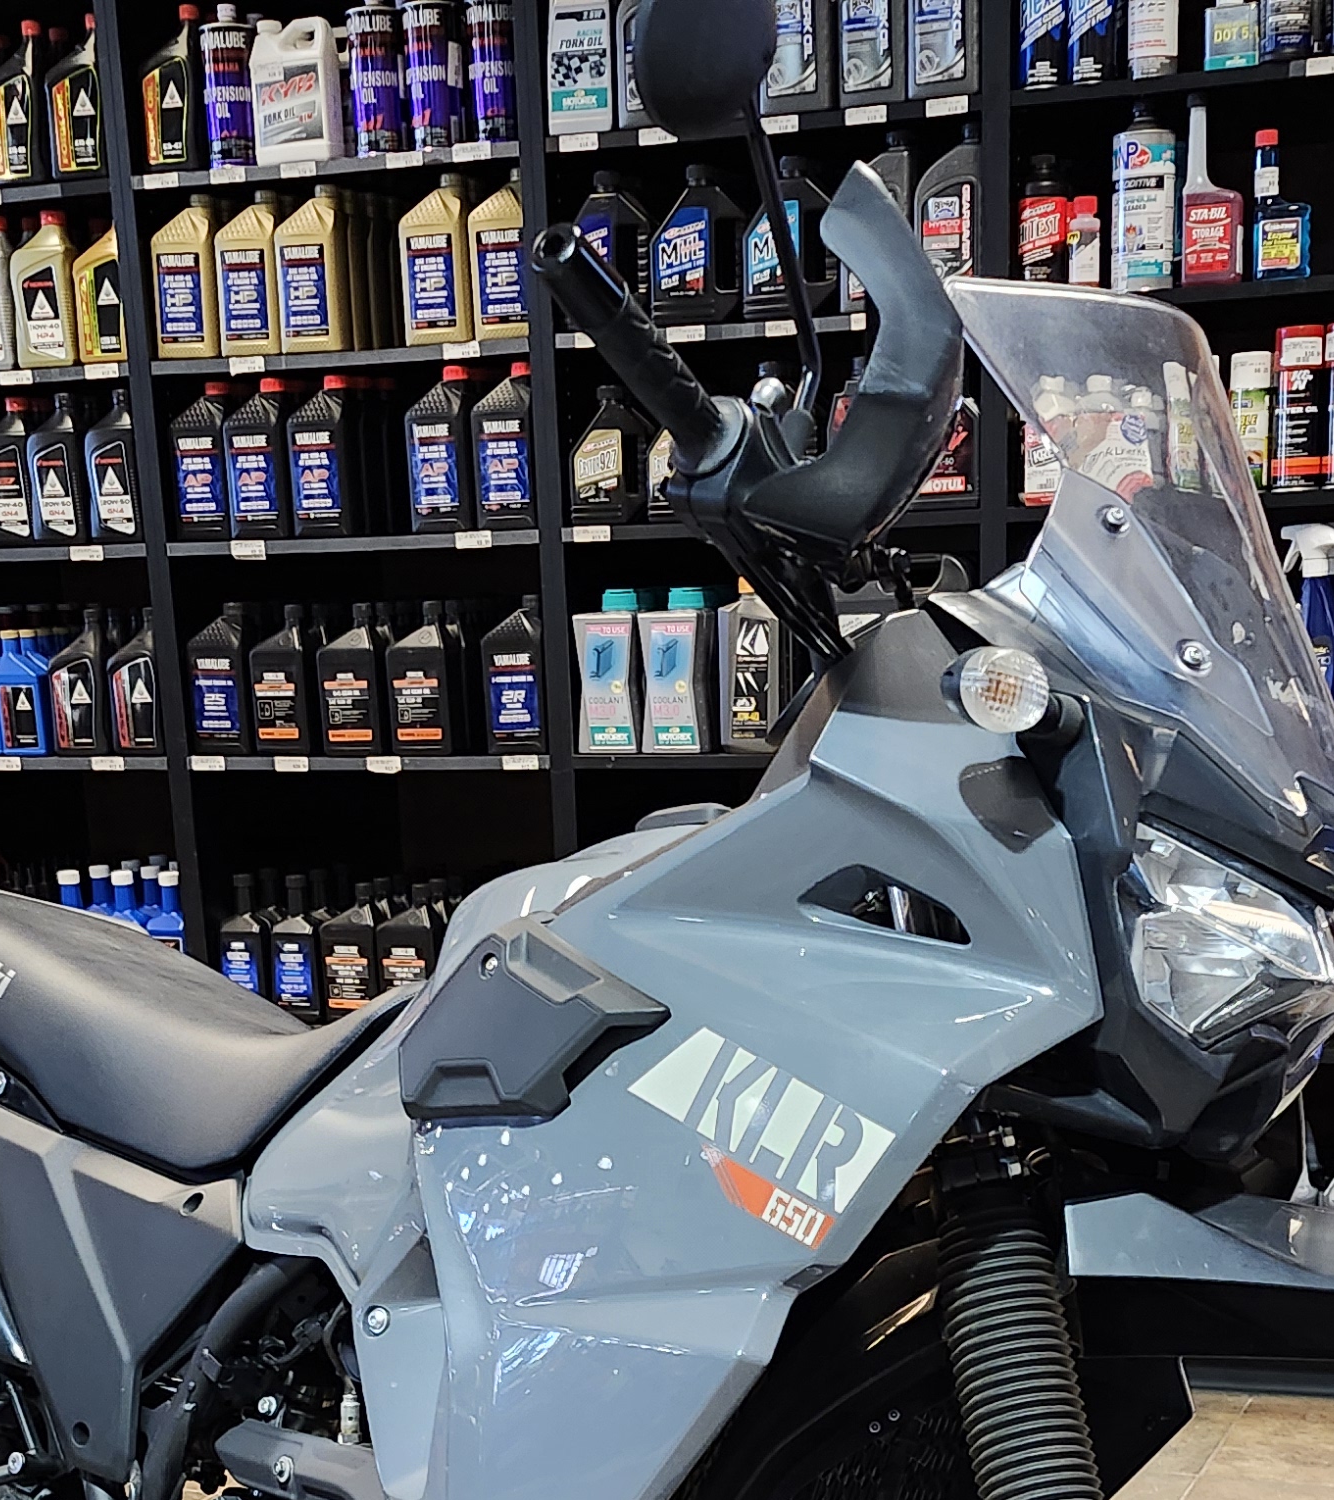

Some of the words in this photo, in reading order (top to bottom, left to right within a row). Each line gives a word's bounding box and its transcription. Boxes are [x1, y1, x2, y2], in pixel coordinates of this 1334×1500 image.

[1214, 29, 1238, 42] DOT
[559, 38, 585, 50] FORK
[586, 36, 603, 48] OIL
[261, 71, 316, 106] KYB
[484, 78, 499, 94] OIL
[216, 102, 231, 118] OIL
[264, 111, 282, 128] FORK
[284, 107, 295, 118] OIL
[1189, 207, 1227, 221] STA-BIL
[480, 230, 520, 244] YAMALUBE
[1192, 227, 1225, 239] STORAGE
[409, 235, 448, 249] YAMALUBE
[224, 251, 260, 264] YAMALUBE
[283, 246, 320, 260] YAMALUBE
[161, 255, 195, 268] YAMALUBE
[29, 322, 60, 332] 10W-40
[1291, 370, 1313, 390] K&N
[419, 462, 449, 476] AP
[489, 458, 519, 473] AP
[184, 472, 212, 487] AP
[238, 471, 266, 485] AP
[301, 468, 329, 483] AP
[501, 690, 526, 703] 2R
[653, 696, 688, 704] COOLANT
[589, 706, 616, 715] M3.0
[653, 706, 680, 715] M3.0
[594, 733, 629, 742] MOTOREX
[657, 732, 692, 742] MOTOREX
[682, 1038, 865, 1211] KLR
[761, 1188, 826, 1247] 650
